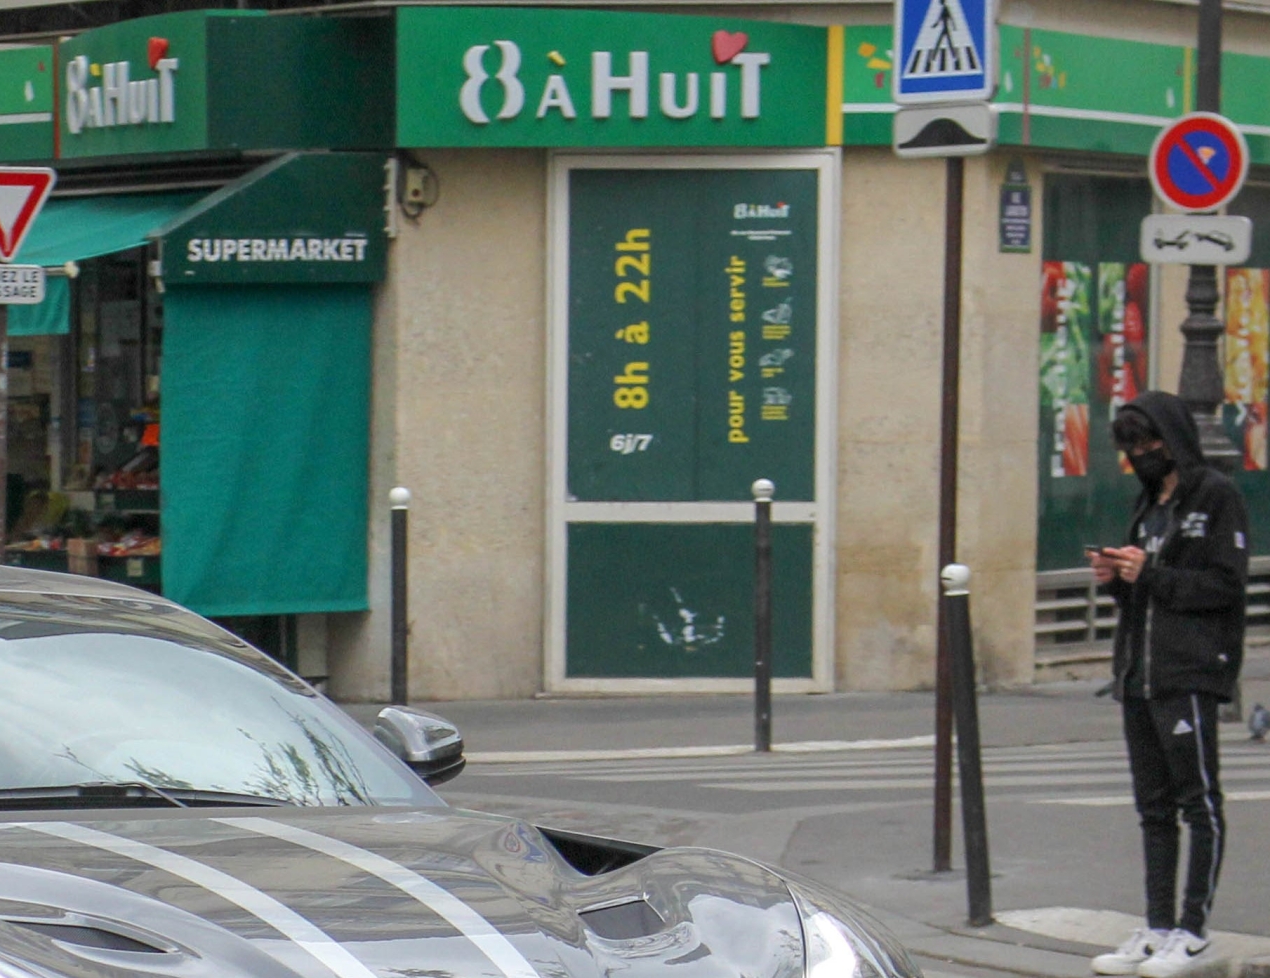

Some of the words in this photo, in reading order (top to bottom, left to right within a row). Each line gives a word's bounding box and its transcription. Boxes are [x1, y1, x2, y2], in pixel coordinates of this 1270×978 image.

[460, 40, 525, 124] 8
[188, 239, 367, 262] SUPERMARKET
[615, 229, 650, 304] 22h
[23, 270, 39, 283] LE
[724, 256, 746, 322] servir
[615, 321, 649, 345] à
[728, 331, 746, 382] vous
[614, 362, 649, 409] 8h
[728, 391, 749, 443] pour
[609, 433, 653, 454] 6j/7
